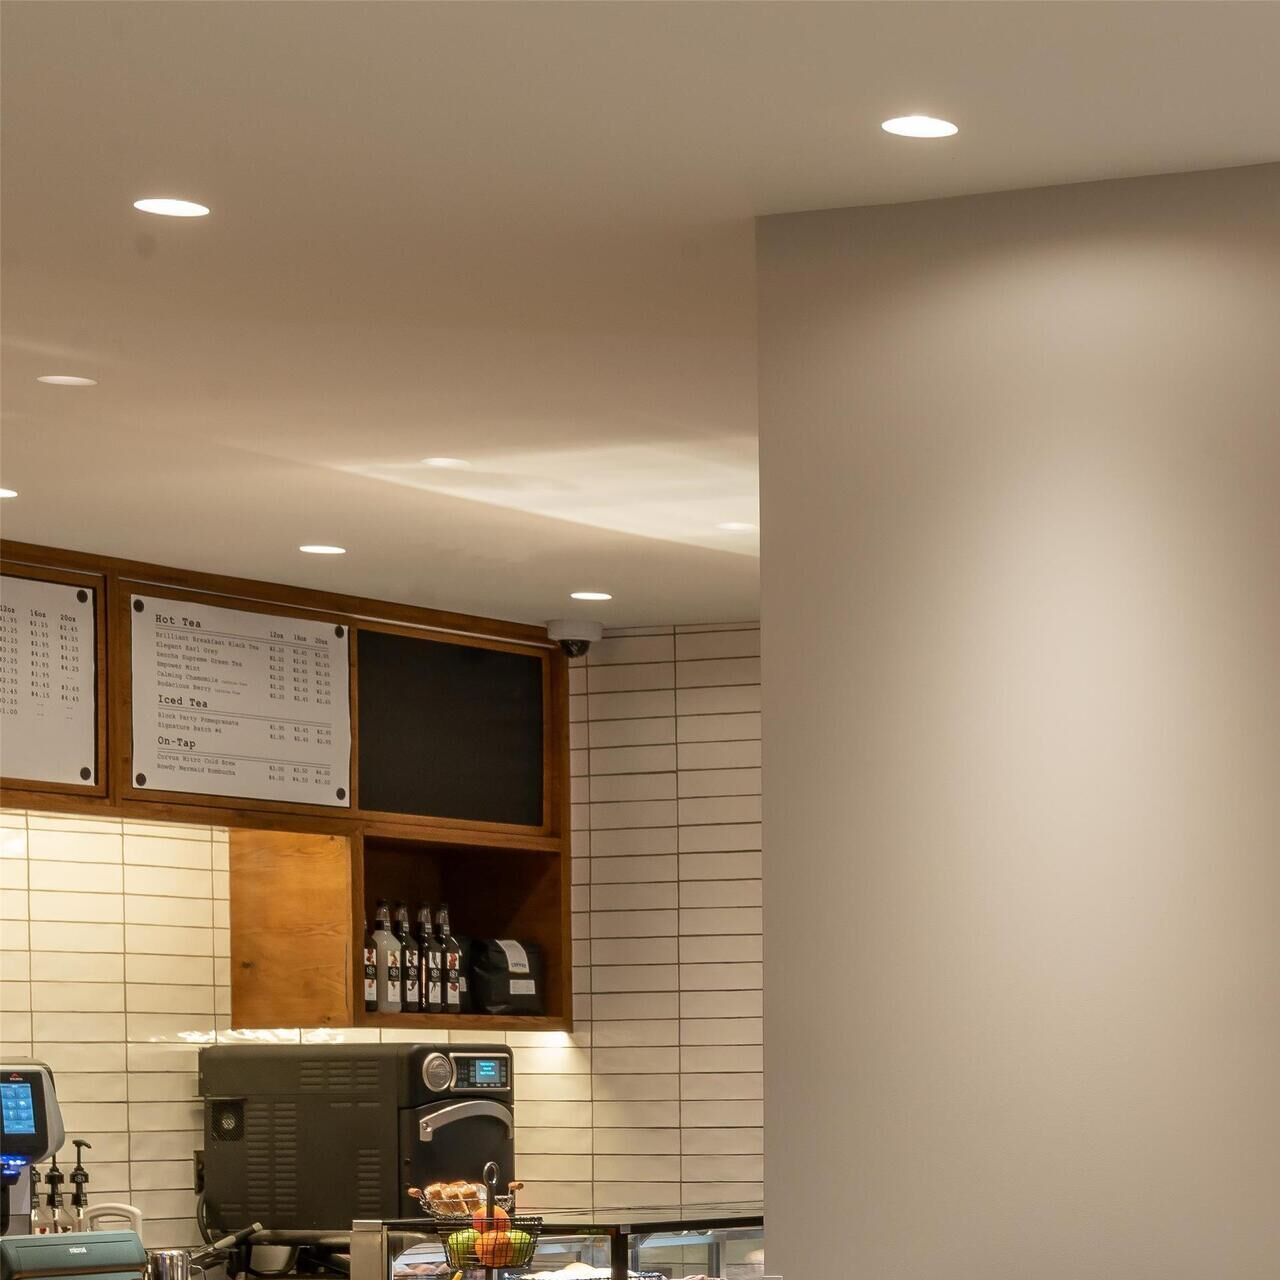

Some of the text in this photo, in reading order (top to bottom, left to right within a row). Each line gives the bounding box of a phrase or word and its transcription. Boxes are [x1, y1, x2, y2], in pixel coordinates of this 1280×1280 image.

[155, 614, 176, 624] Hot
[182, 617, 202, 628] Tea
[158, 694, 208, 708] Iced Tea
[157, 736, 196, 749] On-Tap
